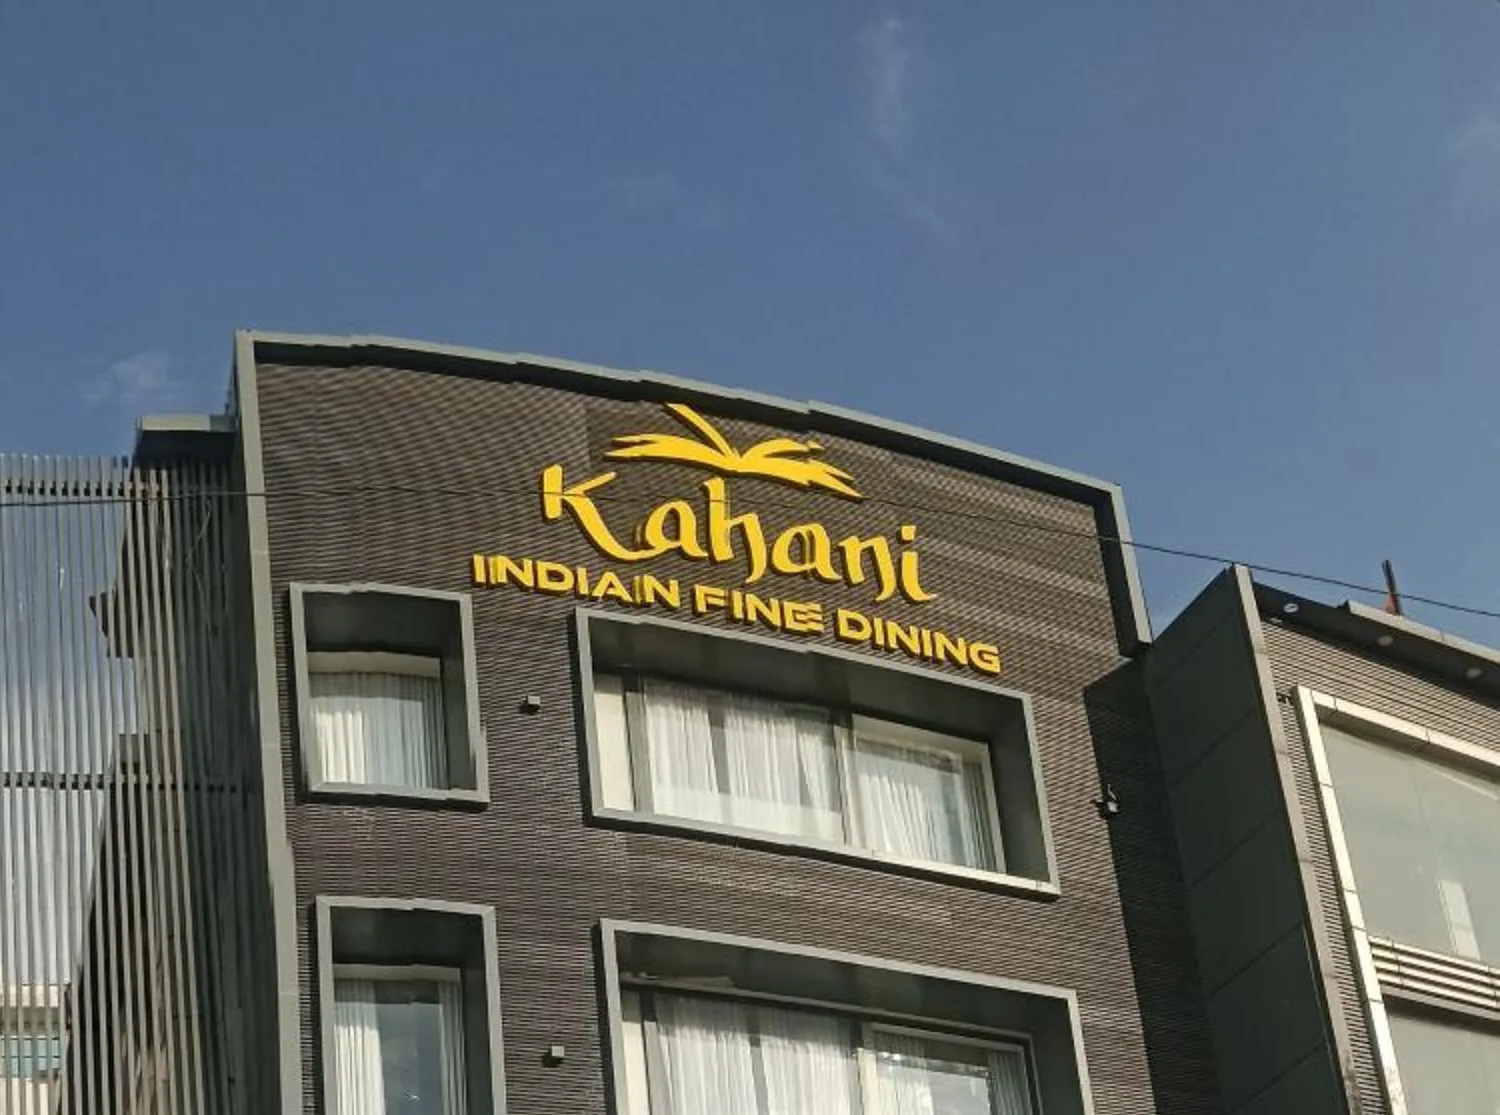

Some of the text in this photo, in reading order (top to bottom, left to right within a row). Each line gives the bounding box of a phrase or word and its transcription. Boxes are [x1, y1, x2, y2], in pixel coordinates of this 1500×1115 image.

[540, 464, 938, 604] Kahani
[471, 553, 1002, 675] INDIAN FINE DINING
